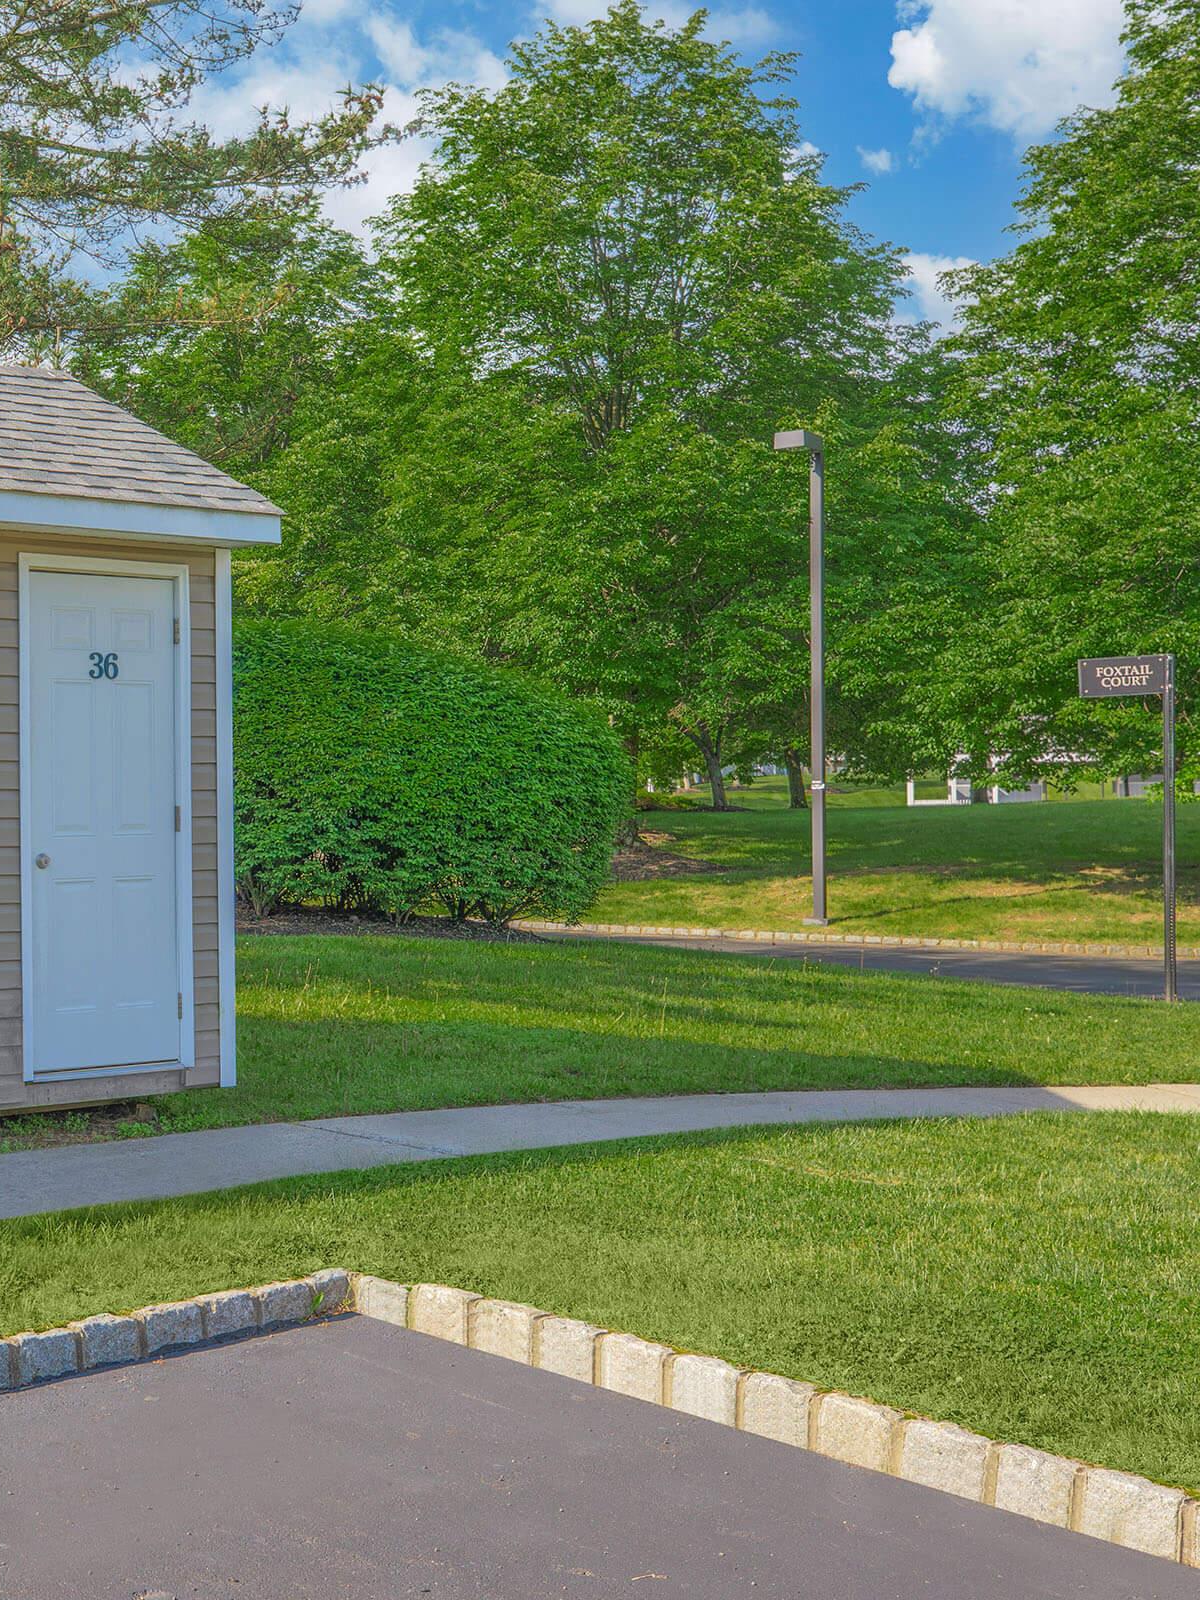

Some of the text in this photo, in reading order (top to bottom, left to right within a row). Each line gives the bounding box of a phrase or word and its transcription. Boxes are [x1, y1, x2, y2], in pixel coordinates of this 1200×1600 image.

[87, 652, 119, 680] 36
[1095, 664, 1154, 678] FOXTAIL
[1100, 675, 1149, 688] COURT
